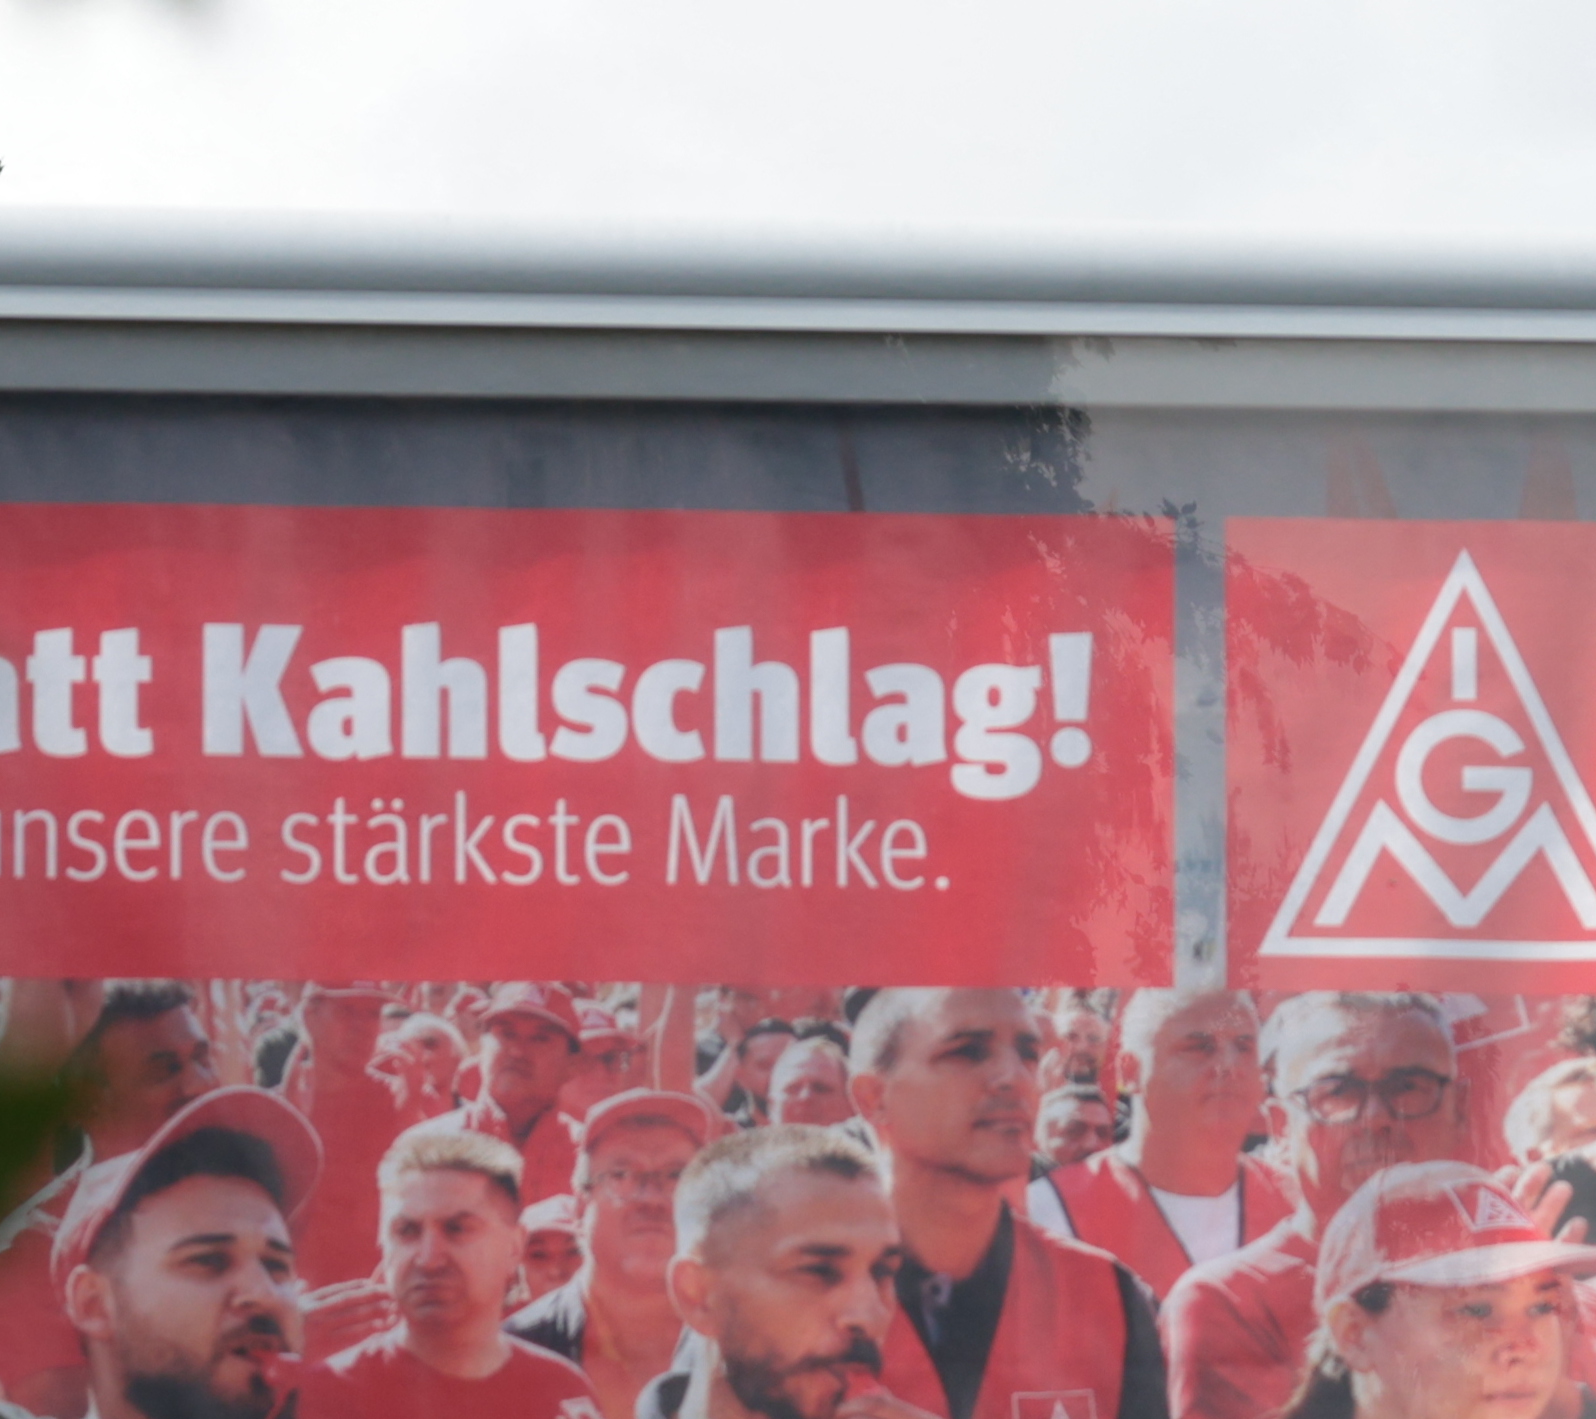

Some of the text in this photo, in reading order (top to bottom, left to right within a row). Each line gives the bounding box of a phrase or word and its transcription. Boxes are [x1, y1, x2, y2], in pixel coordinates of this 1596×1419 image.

[201, 620, 1096, 799] Kahlschlag!
[282, 789, 631, 889] stärkste
[666, 799, 949, 893] Marke.
